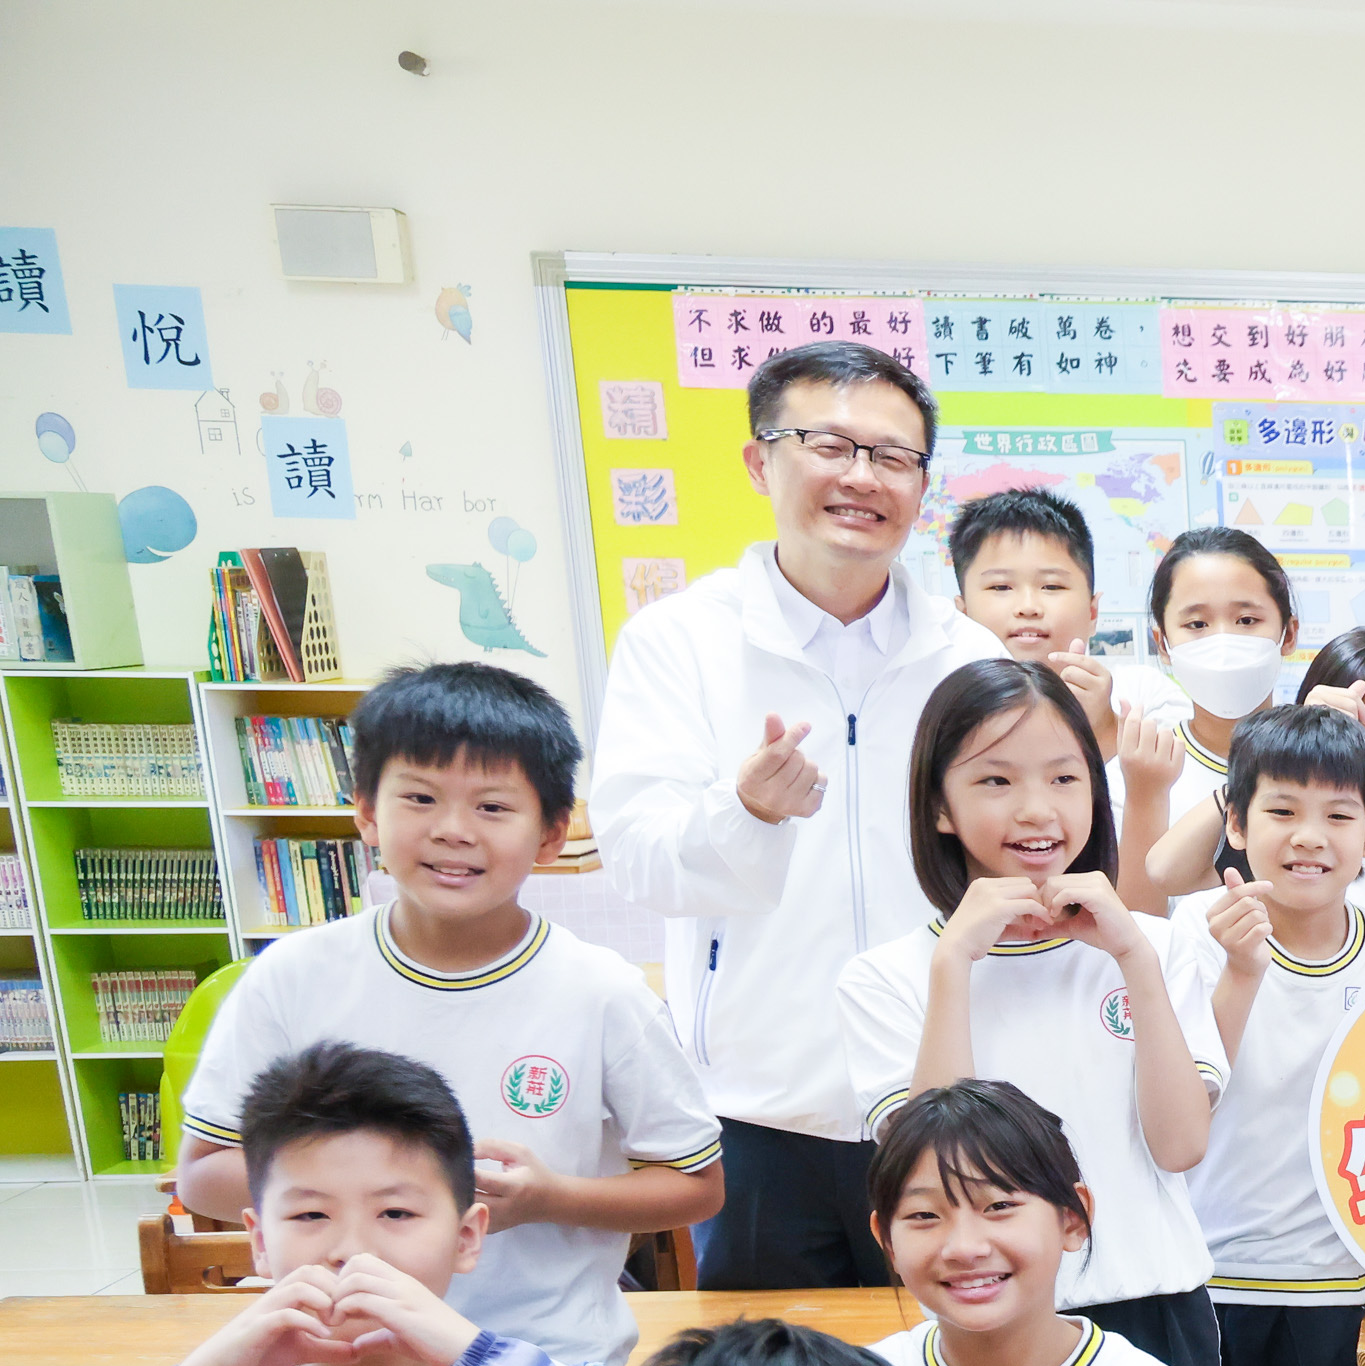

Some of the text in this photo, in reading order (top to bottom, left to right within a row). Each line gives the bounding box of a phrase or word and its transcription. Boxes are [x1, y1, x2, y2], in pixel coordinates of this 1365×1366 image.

[0, 248, 50, 314] 讀
[131, 310, 201, 367] 悅
[688, 309, 912, 336] 不求做的最好
[973, 430, 1100, 456] 世界行政區圖
[277, 438, 337, 500] 讀
[526, 1066, 548, 1096] 新莊
